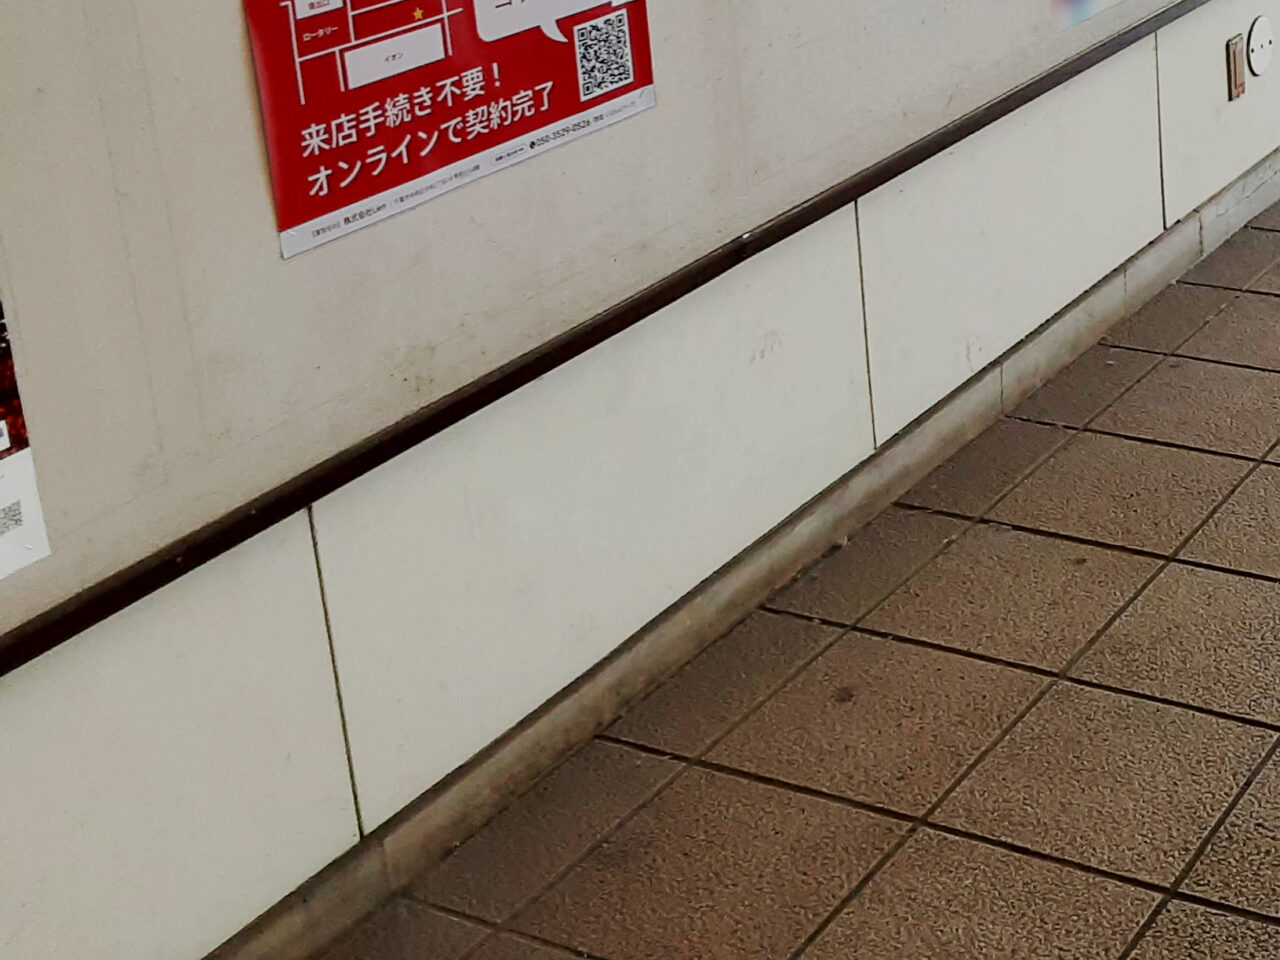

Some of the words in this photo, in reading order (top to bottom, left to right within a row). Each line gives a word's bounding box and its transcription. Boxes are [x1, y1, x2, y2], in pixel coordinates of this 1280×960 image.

[307, 81, 555, 197] オンラインで契約完了
